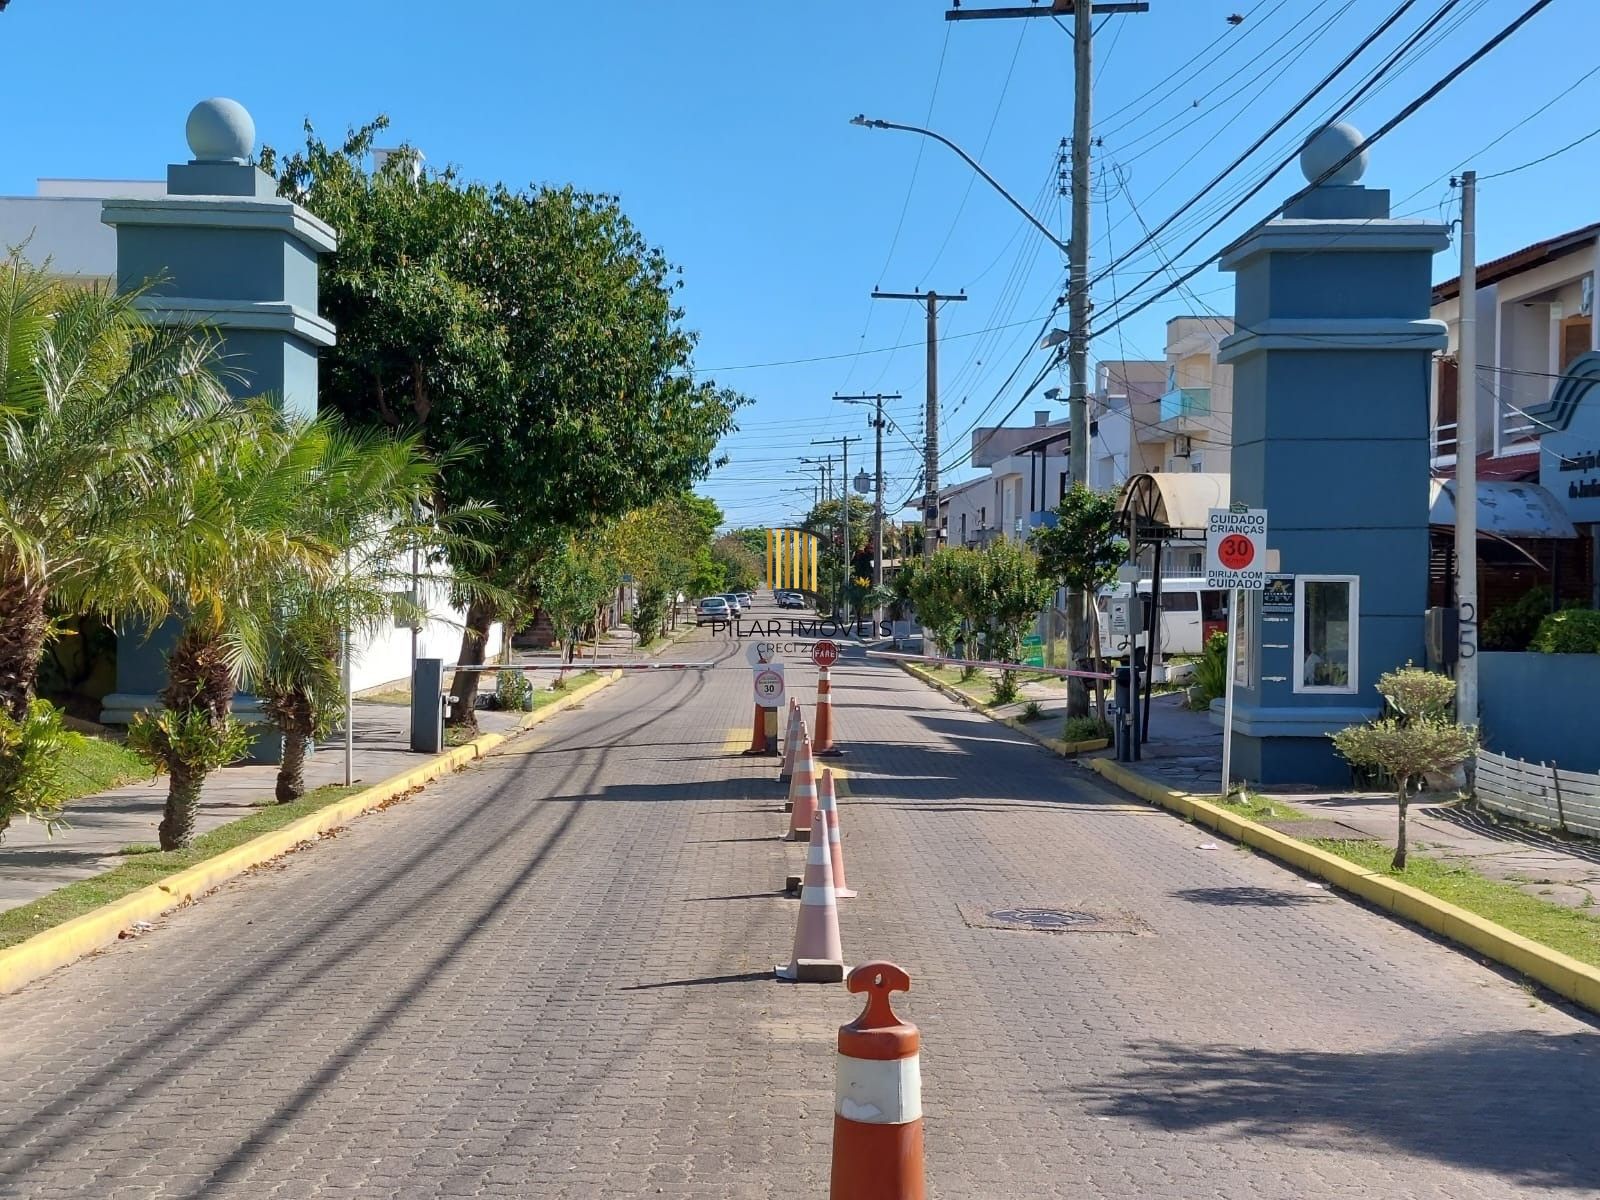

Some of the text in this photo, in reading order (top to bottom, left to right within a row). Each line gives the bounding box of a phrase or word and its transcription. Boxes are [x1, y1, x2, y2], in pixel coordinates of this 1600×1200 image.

[1211, 515, 1264, 524] CUIDADO
[1211, 525, 1264, 535] CRIANÇAS
[1225, 540, 1248, 556] 30
[1208, 579, 1261, 588] CUIDADO
[815, 650, 835, 658] PARE
[764, 685, 774, 693] 30
